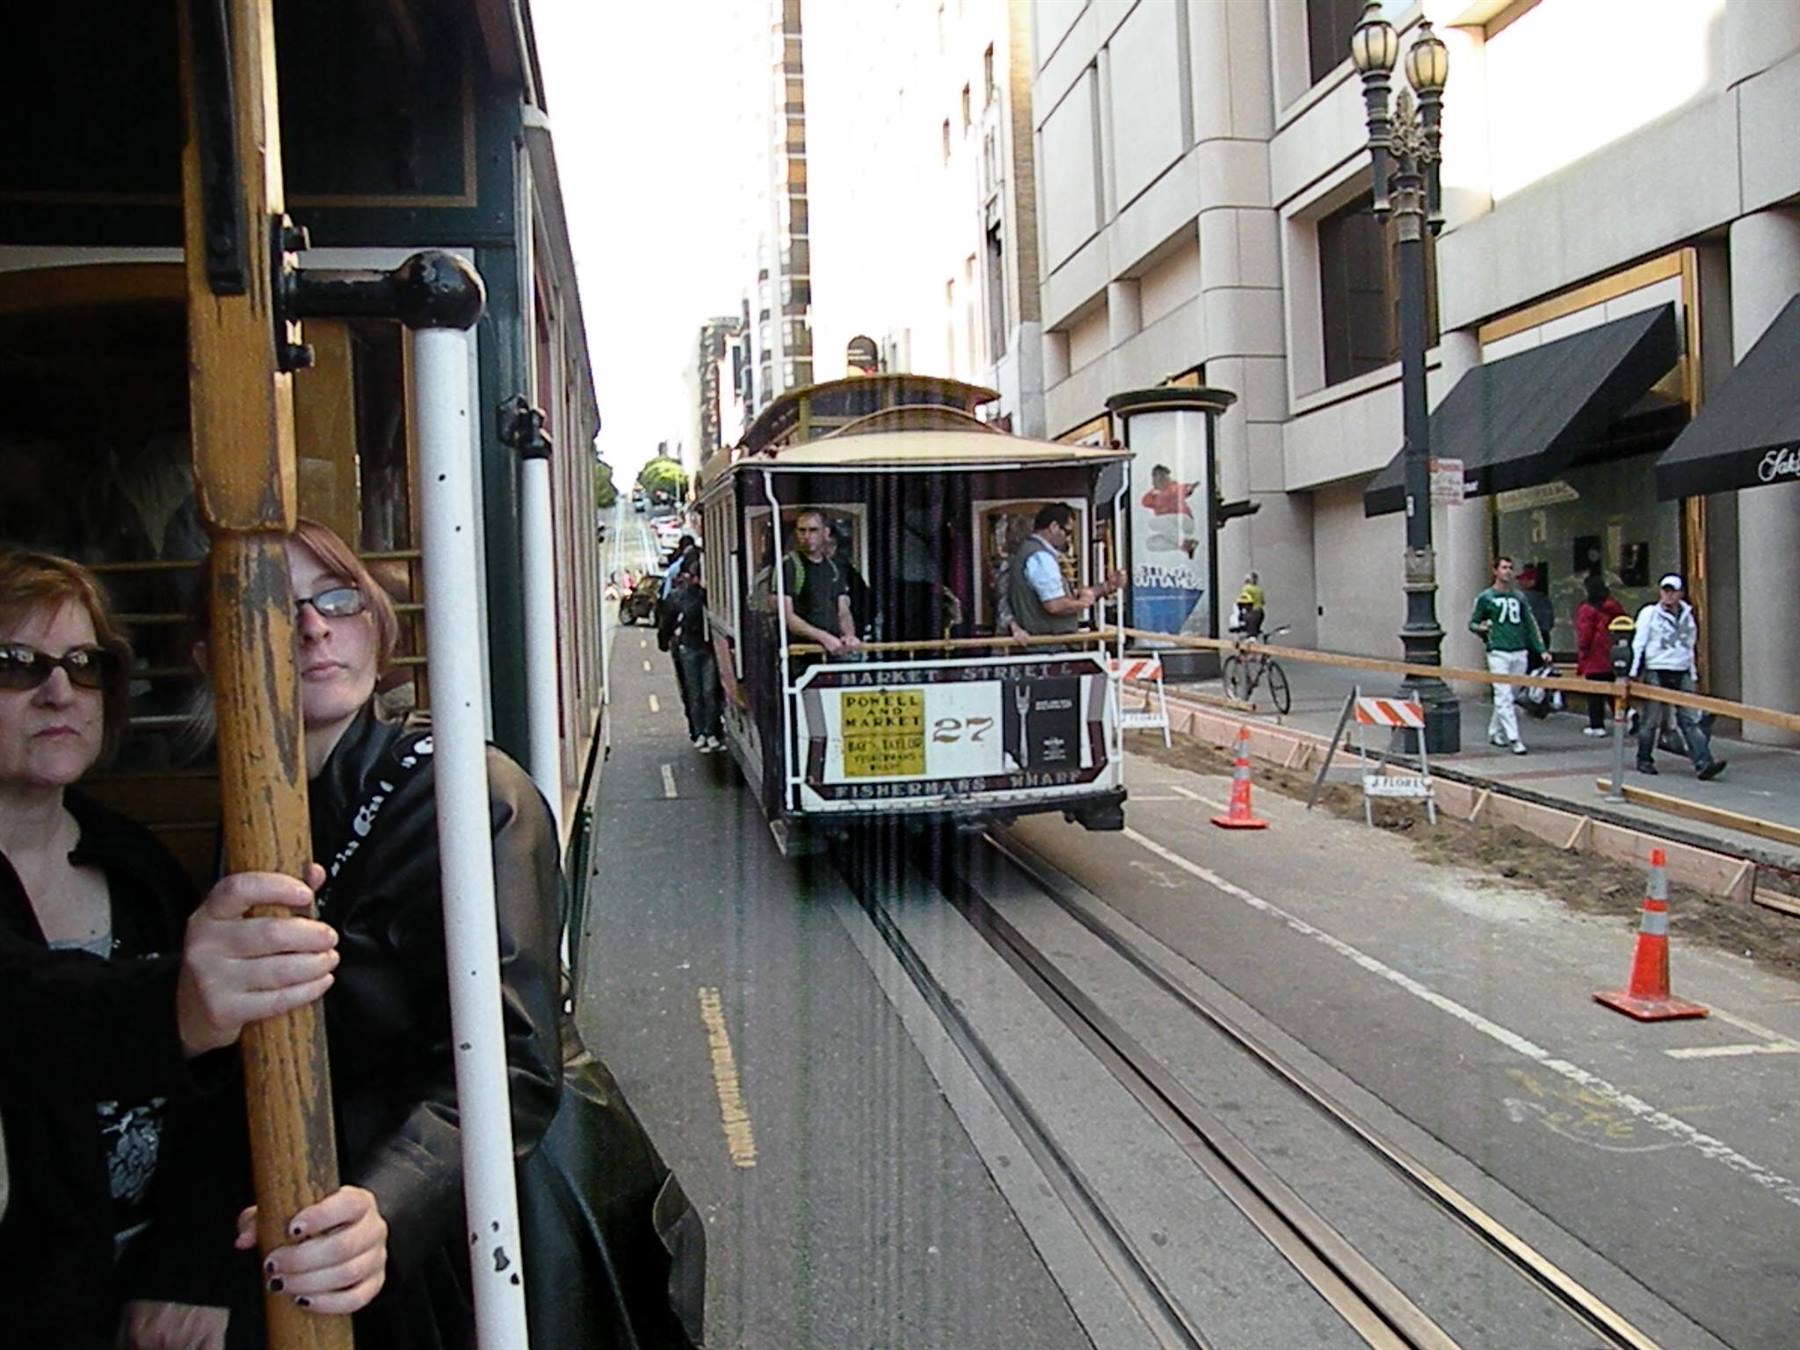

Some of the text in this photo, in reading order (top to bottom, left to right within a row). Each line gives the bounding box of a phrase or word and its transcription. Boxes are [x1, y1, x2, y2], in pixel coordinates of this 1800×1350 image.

[1758, 447, 1800, 482] Sak
[1492, 597, 1521, 623] 78
[840, 669, 939, 686] MARKET
[845, 695, 919, 707] POWELL
[866, 707, 903, 716] AND
[845, 716, 919, 728] MARKET
[932, 716, 994, 743] 27
[834, 777, 987, 799] FISHERMANS
